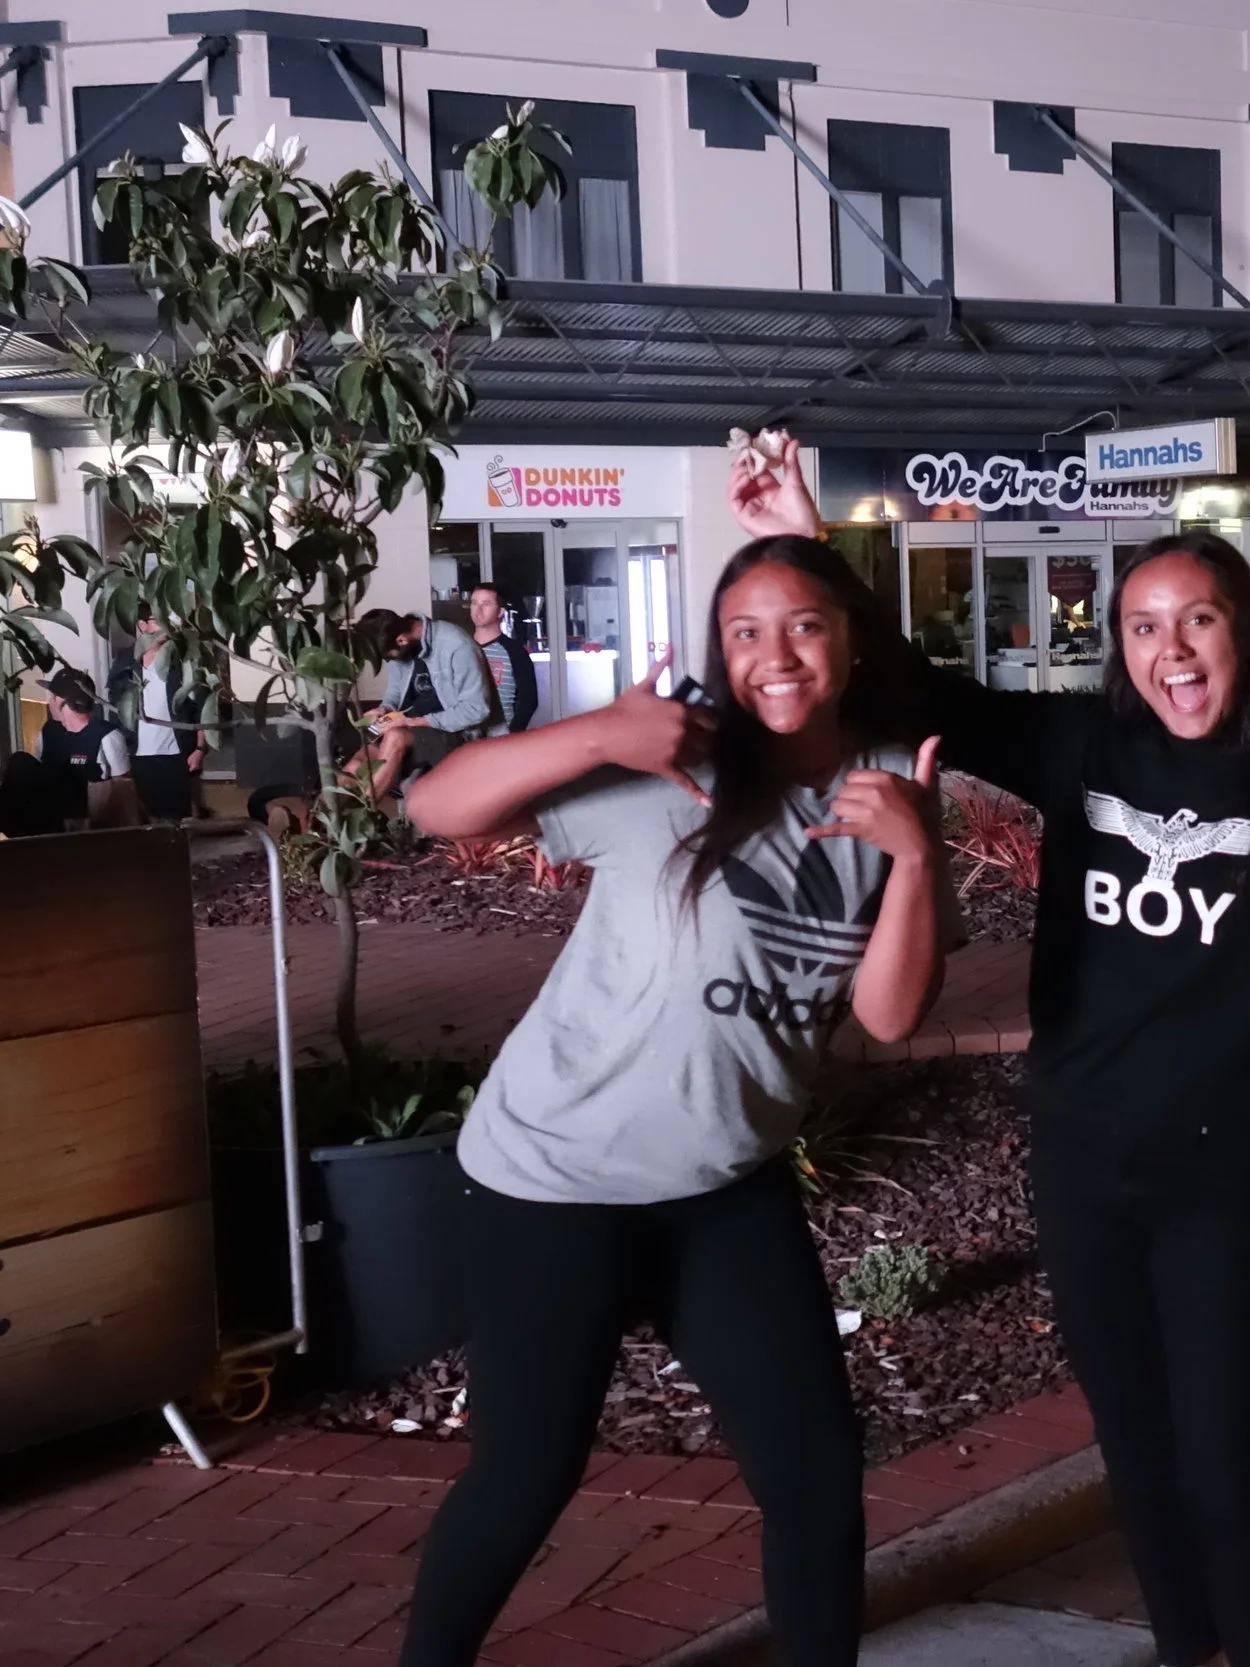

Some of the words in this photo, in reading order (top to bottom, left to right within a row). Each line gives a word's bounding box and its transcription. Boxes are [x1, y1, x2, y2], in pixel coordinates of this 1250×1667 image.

[1098, 437, 1203, 470] Hannahs
[524, 467, 625, 486] DUNKIN'
[911, 458, 977, 500] We
[977, 462, 1057, 501] Are
[525, 488, 621, 506] DONUTS
[1090, 500, 1149, 511] Hannahs
[1084, 869, 1237, 945] BOY
